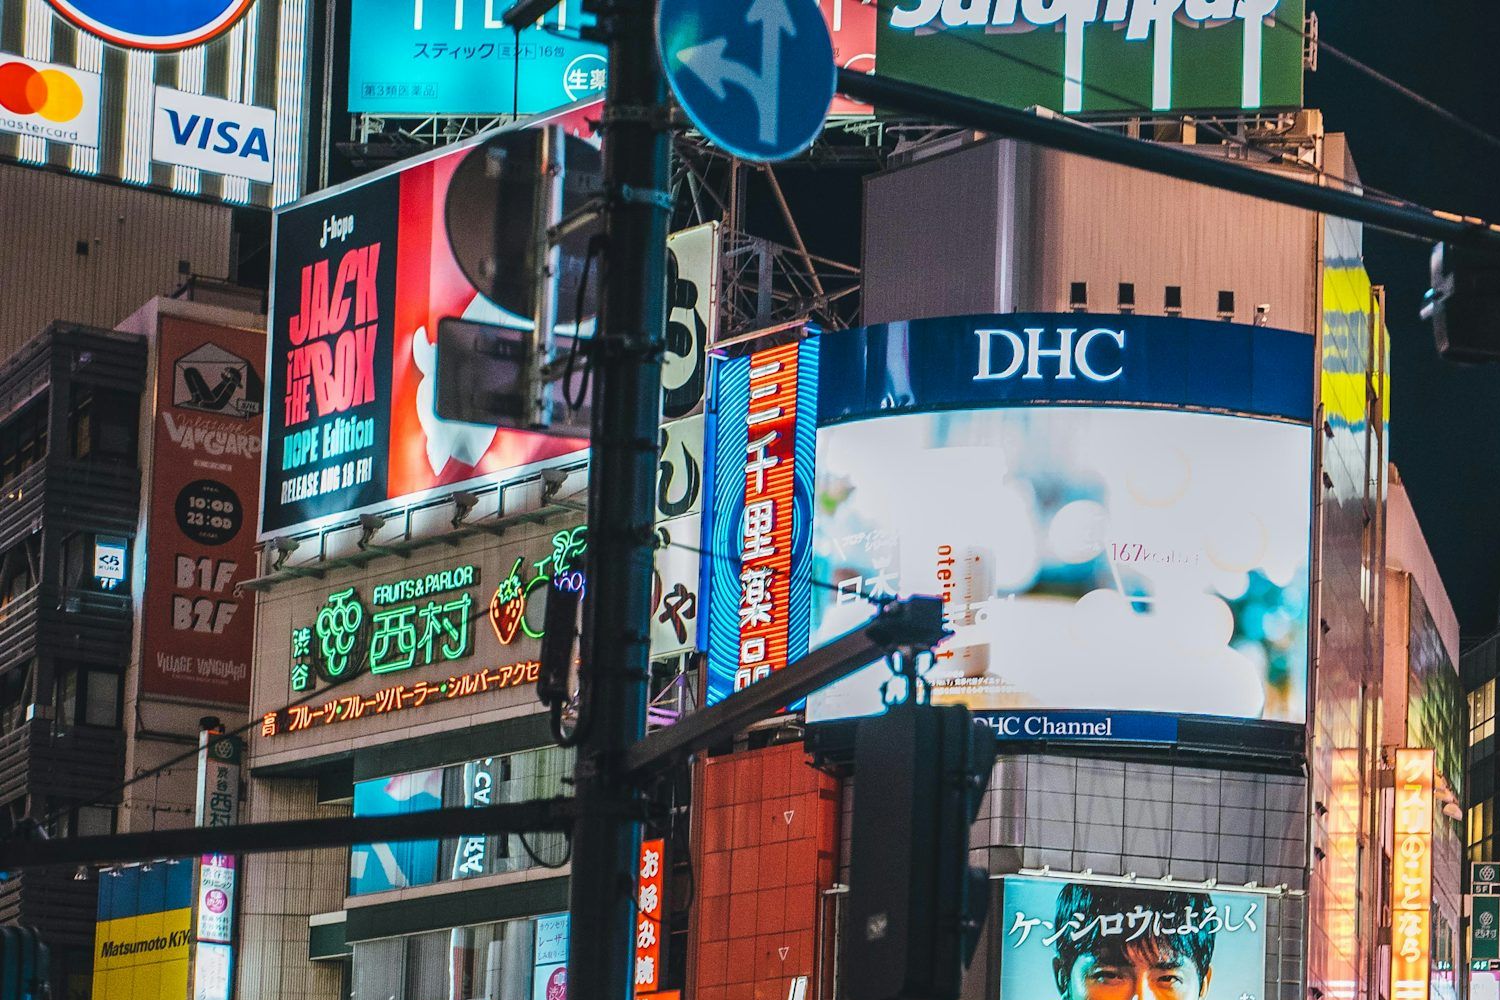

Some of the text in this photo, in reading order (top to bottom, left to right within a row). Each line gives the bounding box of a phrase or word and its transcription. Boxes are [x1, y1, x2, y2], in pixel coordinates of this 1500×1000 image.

[413, 43, 494, 60] スティック
[159, 107, 270, 163] VISA
[320, 213, 354, 248] j-hope
[289, 242, 382, 346] JACK
[310, 322, 379, 418] BOX
[973, 329, 1125, 381] DHC
[282, 416, 374, 471] HOPE Edition
[280, 466, 319, 505] RELEASE
[319, 461, 341, 495] AUG
[355, 456, 373, 486] FRI
[733, 359, 783, 694] 三千里薬品
[99, 555, 120, 566] くら
[175, 554, 239, 594] B1F
[173, 598, 239, 635] B2F
[369, 592, 472, 676] 西村
[291, 628, 312, 692] 渋谷
[1025, 716, 1112, 737] Channel
[1399, 758, 1428, 963] クスリのことなら
[633, 849, 661, 986] お好み焼
[1008, 902, 1259, 949] ケンシロウによろしく
[101, 936, 168, 959] Matsumoto
[1472, 960, 1488, 970] 4F
